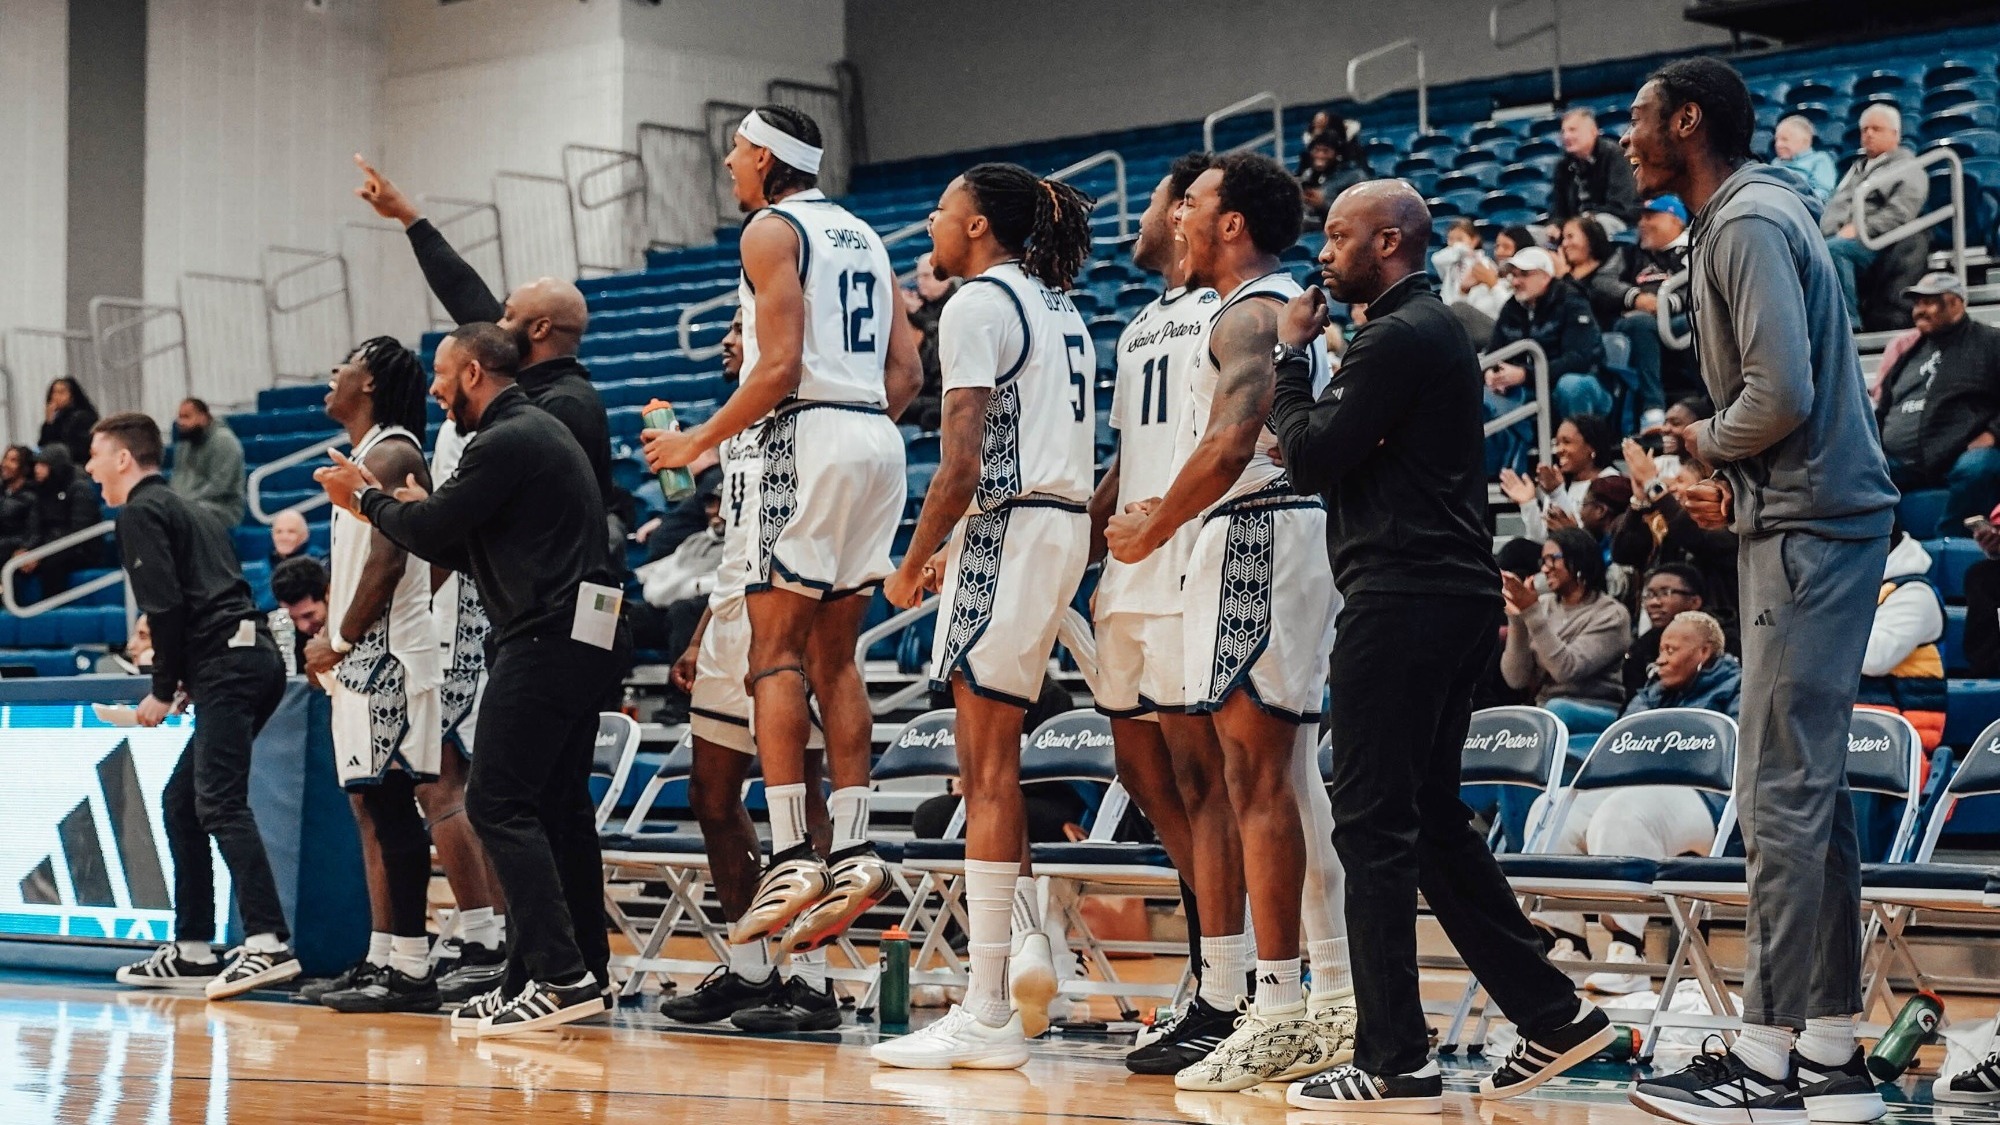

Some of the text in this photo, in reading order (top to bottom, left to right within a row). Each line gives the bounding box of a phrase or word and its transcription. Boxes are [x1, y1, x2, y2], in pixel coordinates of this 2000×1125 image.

[838, 268, 877, 353] 12
[1127, 320, 1201, 353] Saint Peter's
[1063, 334, 1086, 423] 5
[1141, 353, 1169, 426] 11
[731, 472, 745, 527] 4
[899, 728, 934, 748] Saint
[1034, 729, 1076, 750] Saint
[1463, 729, 1539, 752] aint Peter's
[1608, 730, 1716, 754] Saint Peter's
